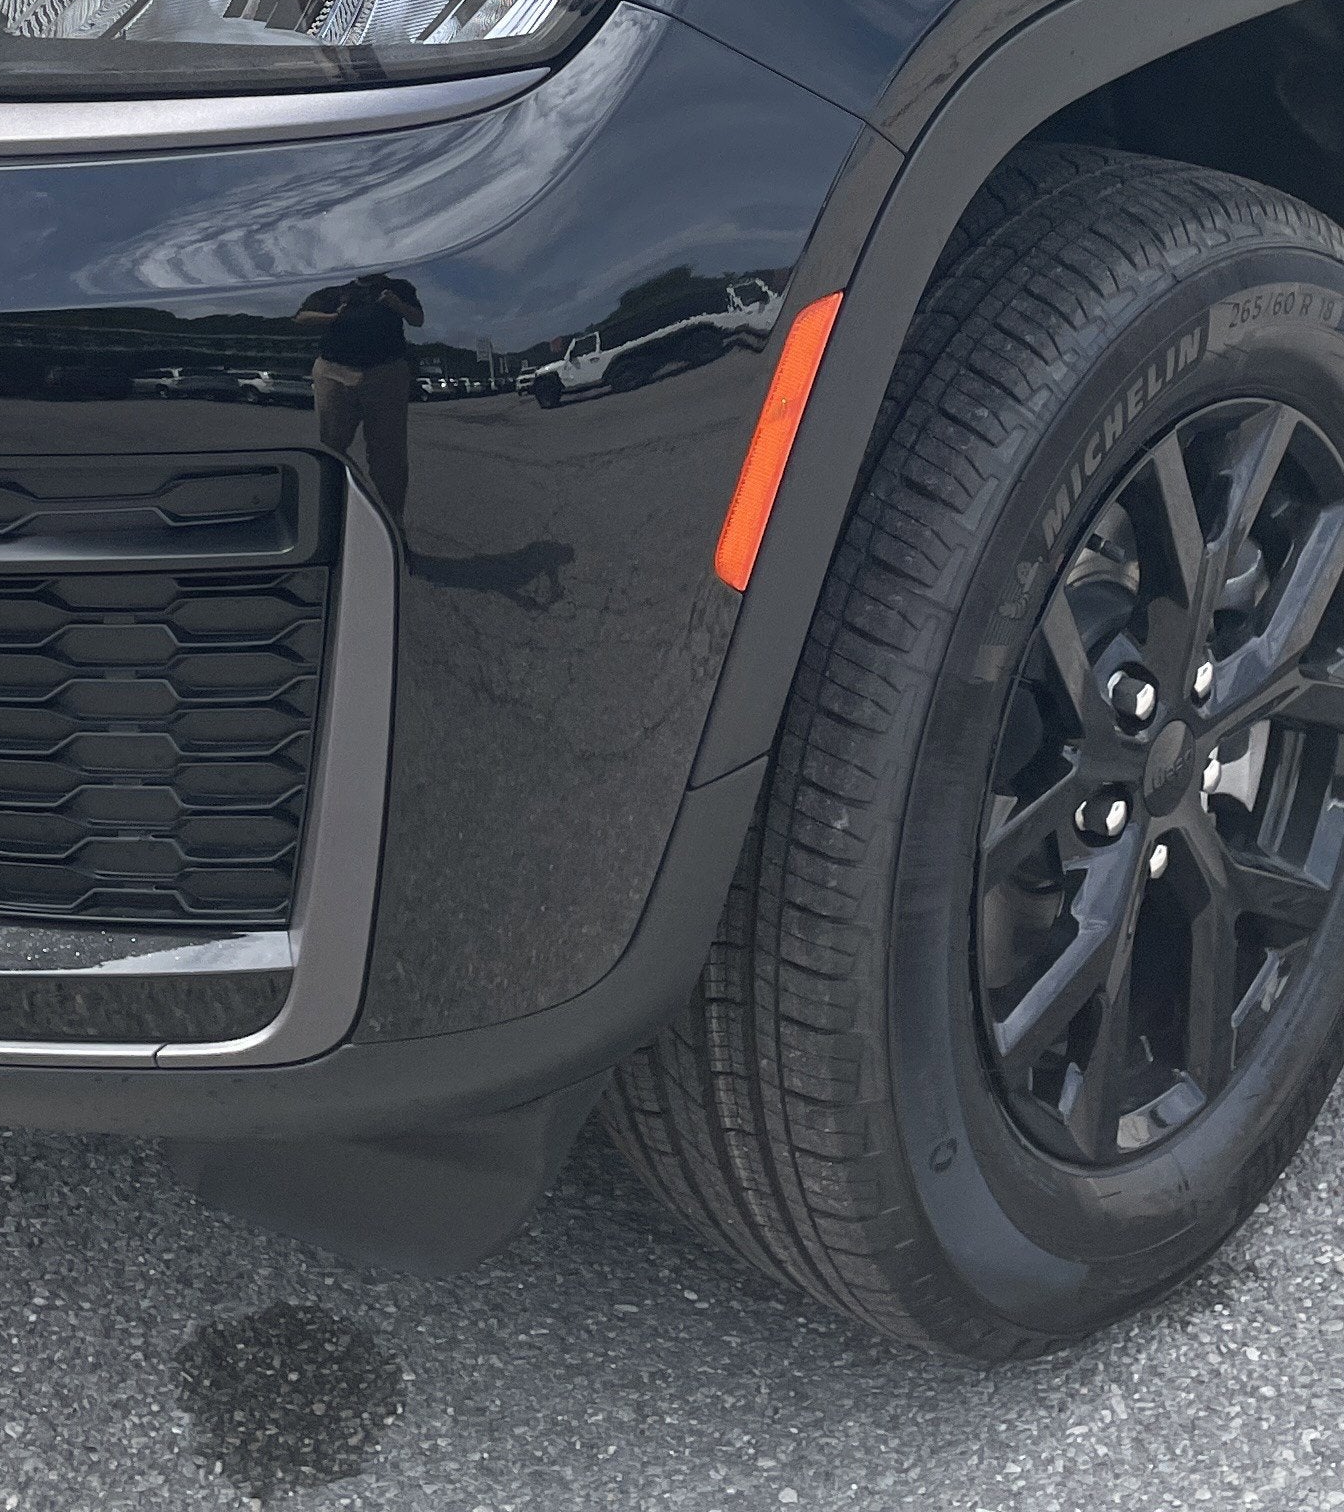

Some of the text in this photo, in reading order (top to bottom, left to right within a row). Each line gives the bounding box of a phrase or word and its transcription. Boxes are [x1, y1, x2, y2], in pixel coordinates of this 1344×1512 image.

[1228, 291, 1336, 328] 265/60 R 18
[1042, 326, 1203, 550] MICHELIN
